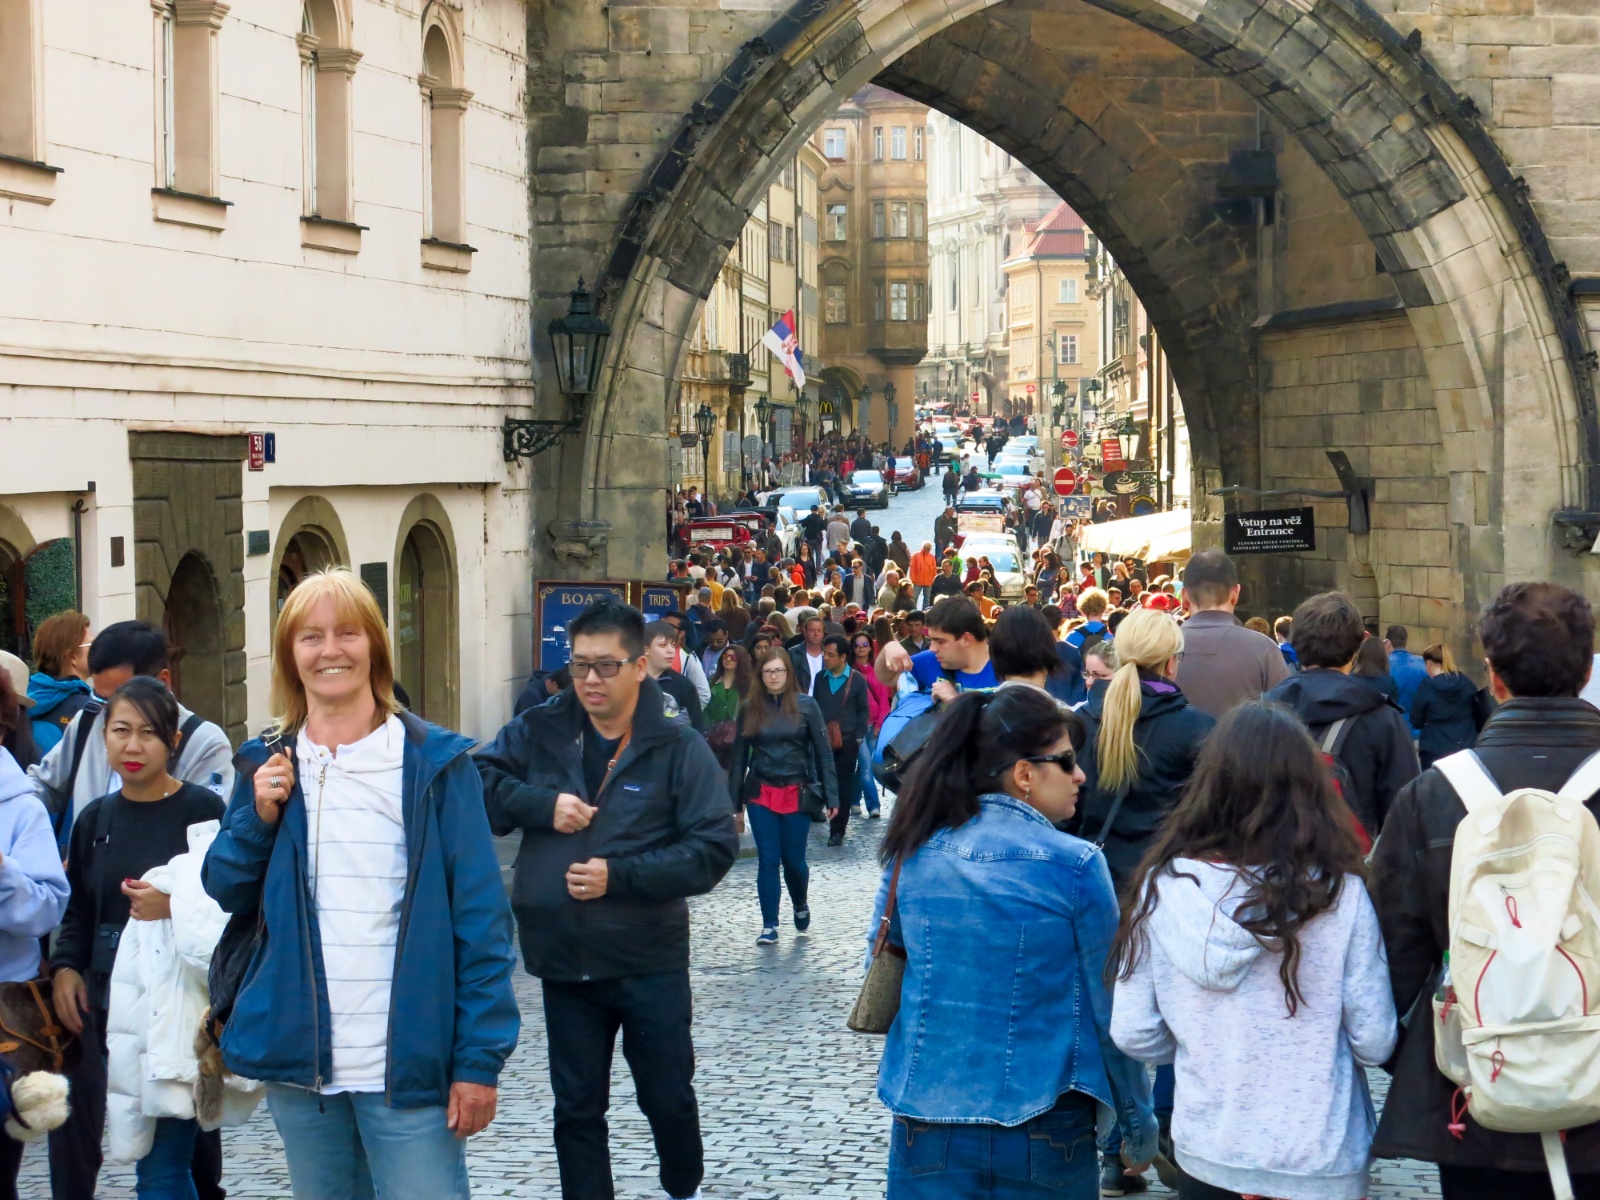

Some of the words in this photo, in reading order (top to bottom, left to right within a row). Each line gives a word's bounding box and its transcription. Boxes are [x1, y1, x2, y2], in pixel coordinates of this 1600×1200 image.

[254, 436, 262, 451] 56
[1238, 518, 1267, 528] Vstup
[1269, 518, 1283, 526] na
[1284, 516, 1302, 525] věž
[1246, 528, 1294, 536] Entrance
[649, 594, 671, 606] TRIPS
